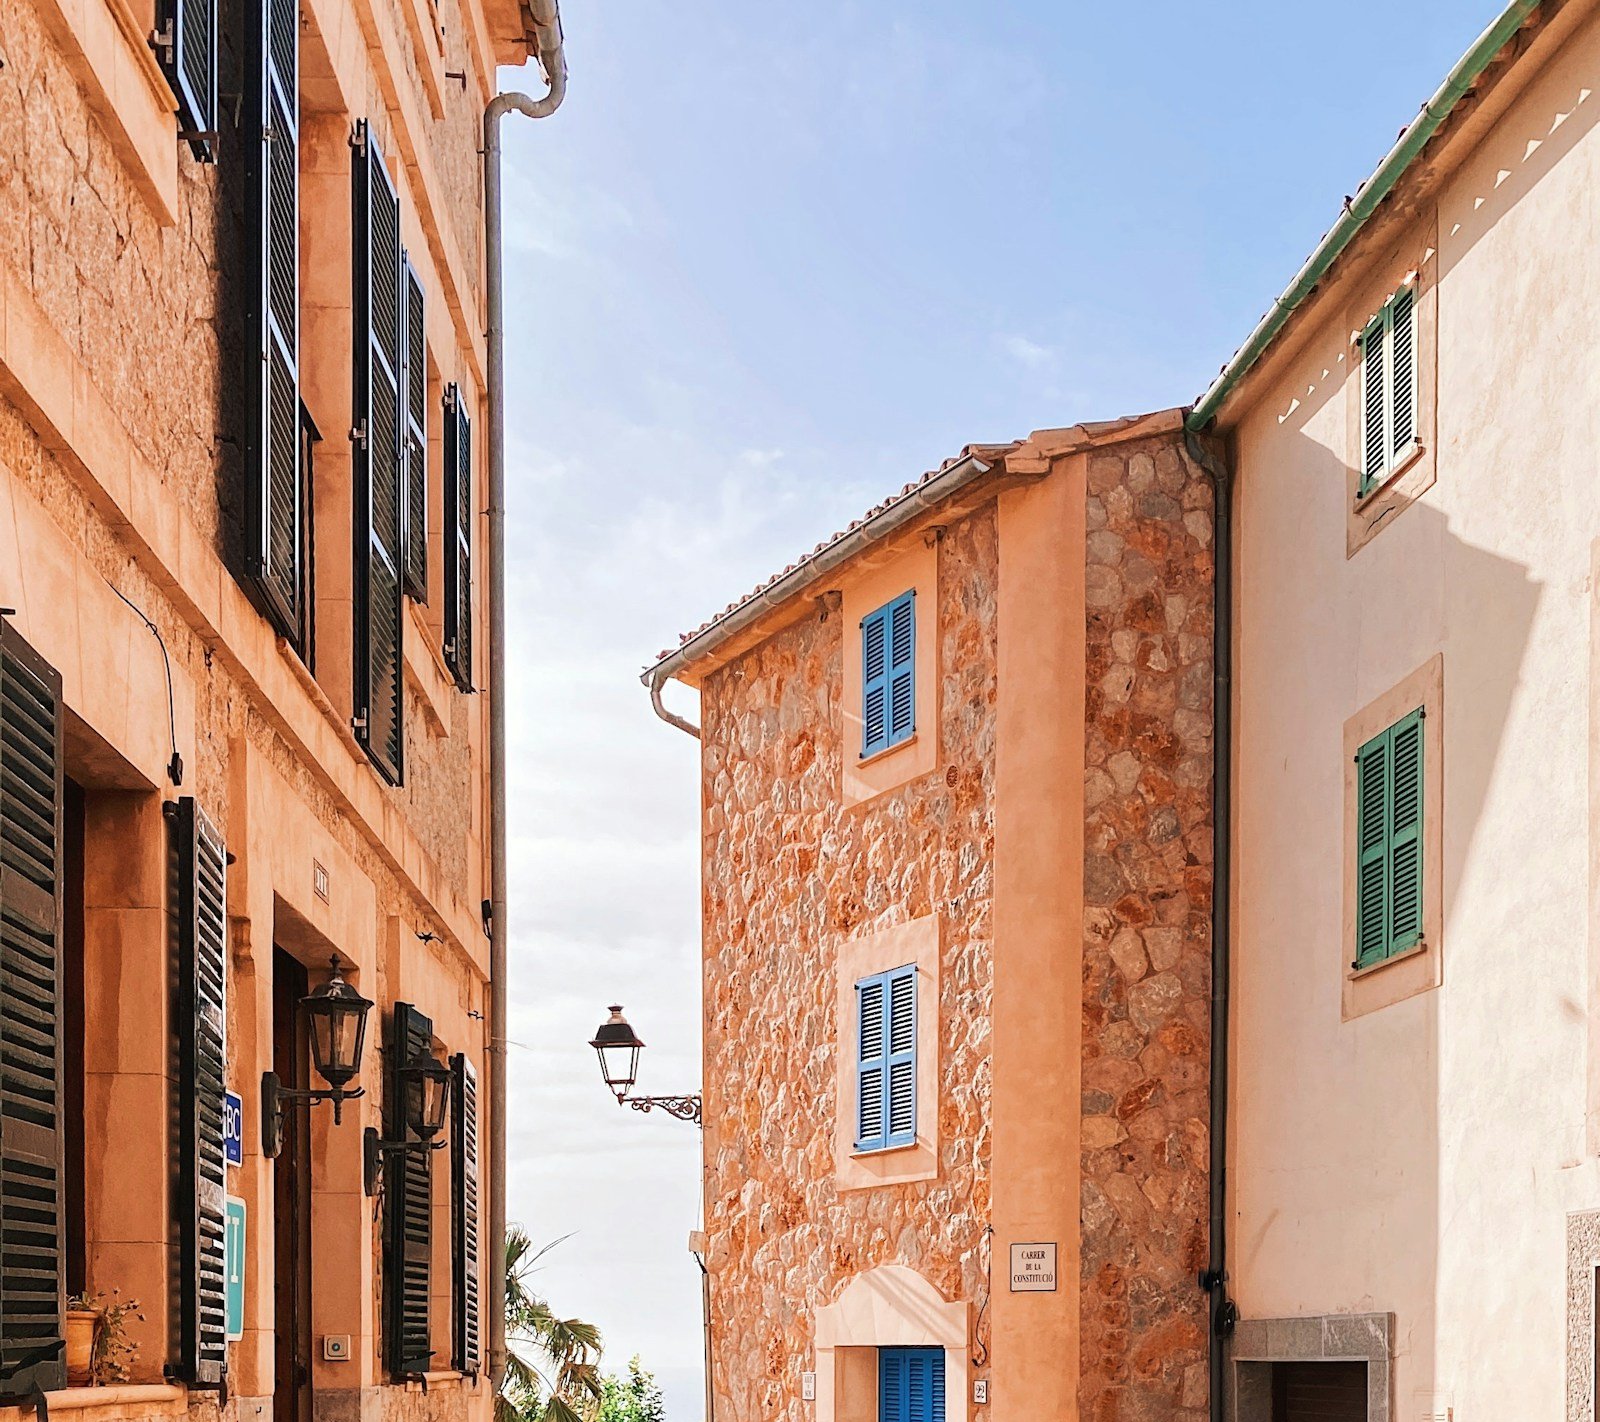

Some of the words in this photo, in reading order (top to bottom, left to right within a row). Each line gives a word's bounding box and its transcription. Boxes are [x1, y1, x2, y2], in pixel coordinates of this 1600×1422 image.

[1021, 1250, 1046, 1260] CARRER
[1025, 1263, 1032, 1271] DE
[1034, 1263, 1041, 1271] LA
[1013, 1271, 1054, 1284] CONSTITUCIÓ
[976, 1384, 985, 1399] 22
